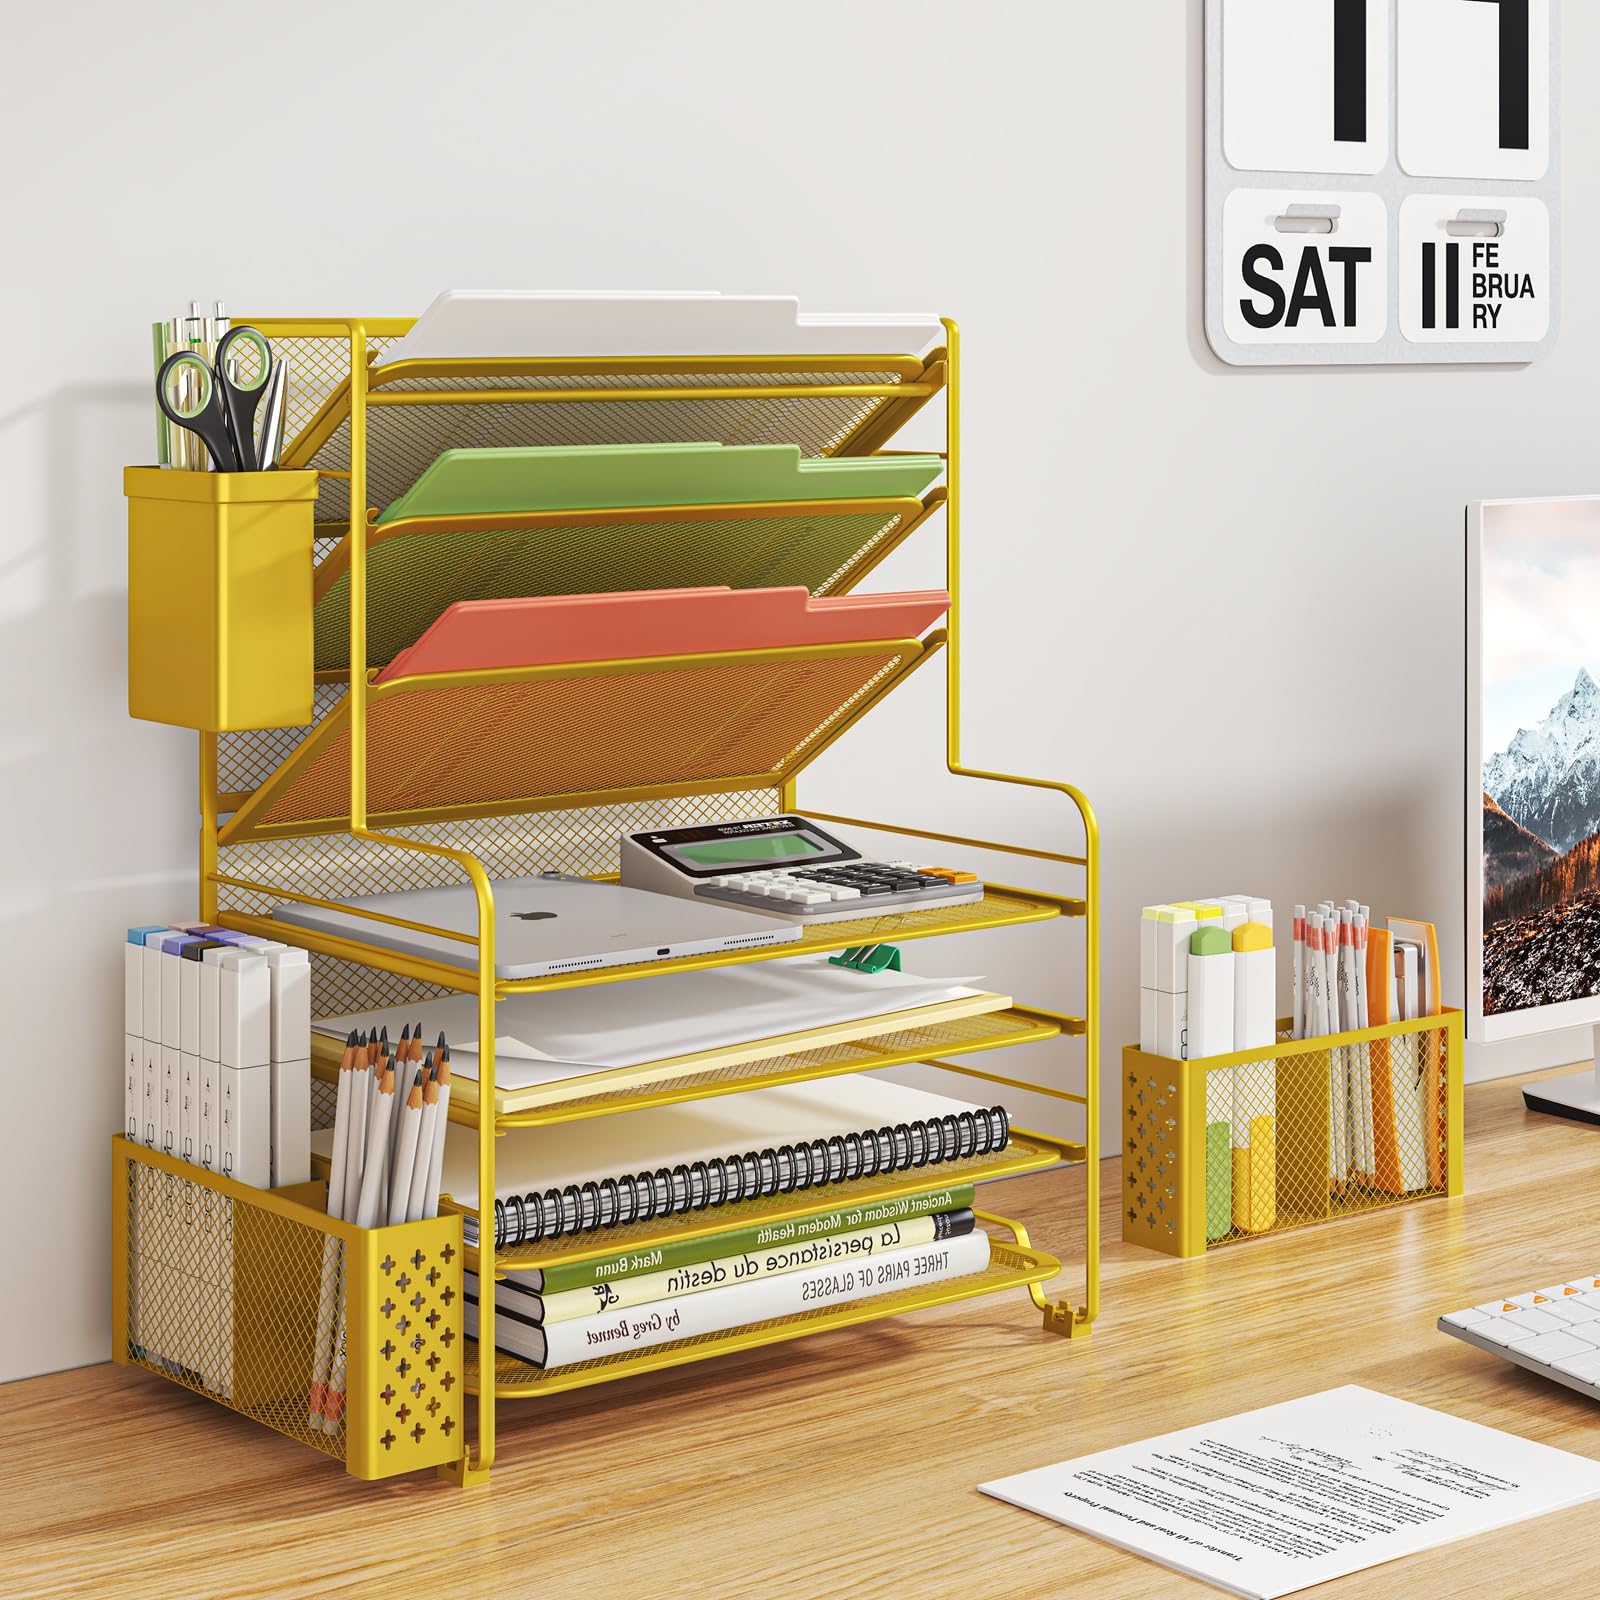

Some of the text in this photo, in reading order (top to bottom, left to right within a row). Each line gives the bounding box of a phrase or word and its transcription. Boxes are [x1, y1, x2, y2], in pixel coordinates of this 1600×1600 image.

[1472, 242, 1499, 268] FE
[1239, 243, 1372, 329] SAT
[1472, 273, 1535, 299] BRUA
[1472, 304, 1502, 329] RY
[1063, 1490, 1101, 1510] Property
[1098, 1503, 1138, 1522] Personal
[1136, 1519, 1156, 1530] and
[1202, 1544, 1243, 1562] Transfer
